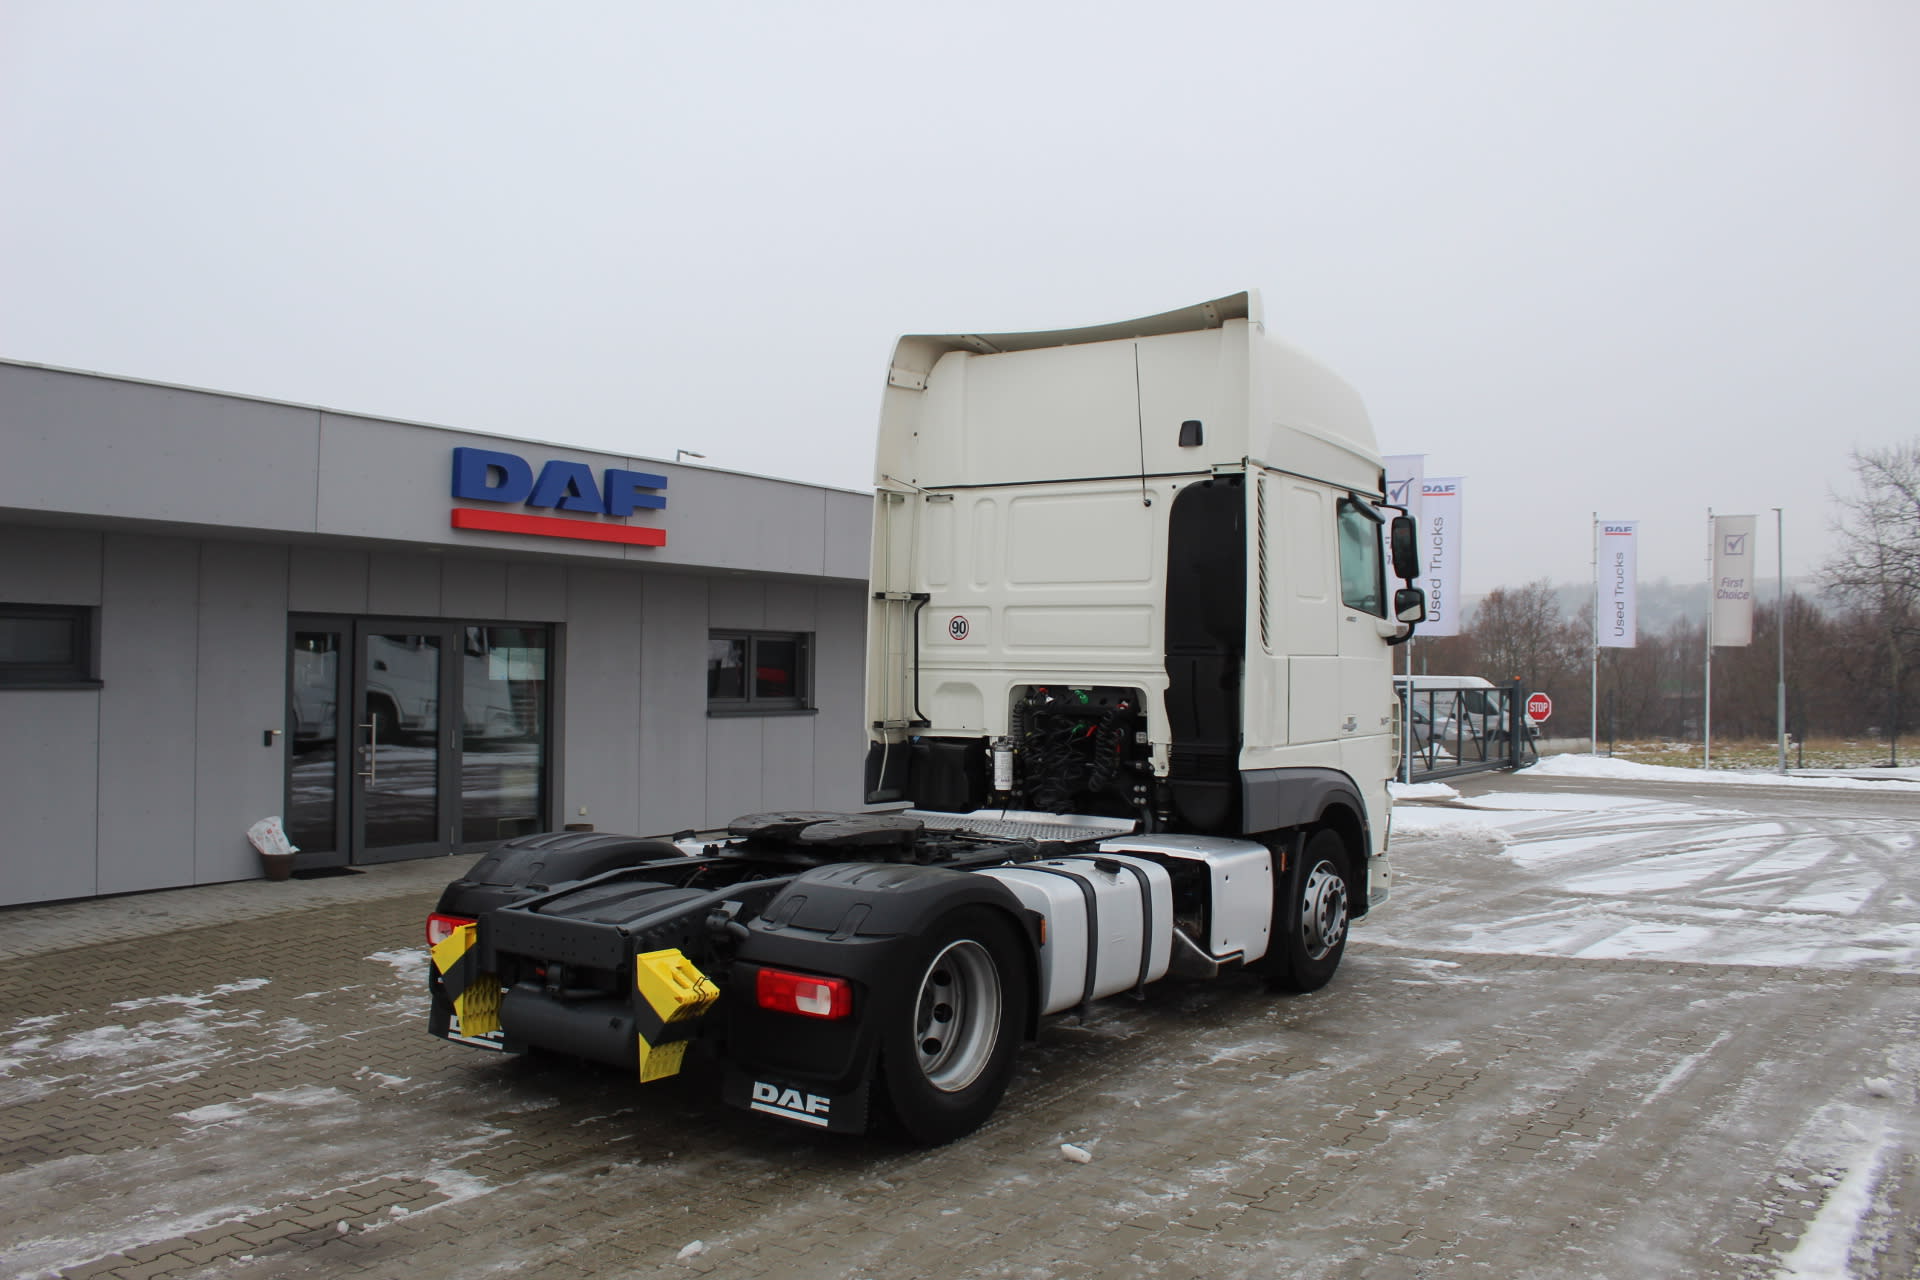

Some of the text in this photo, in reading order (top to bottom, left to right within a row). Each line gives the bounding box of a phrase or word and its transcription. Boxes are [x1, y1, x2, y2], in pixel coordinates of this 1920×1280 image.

[452, 447, 668, 516] DAF
[1421, 484, 1456, 493] DAF
[1428, 516, 1444, 622] Used Trucks
[1720, 577, 1744, 588] First
[1614, 552, 1625, 637] Used Trucks
[1716, 589, 1750, 600] Choice
[952, 620, 967, 635] 90
[1530, 702, 1549, 713] STOP
[752, 1081, 831, 1114] DAF
